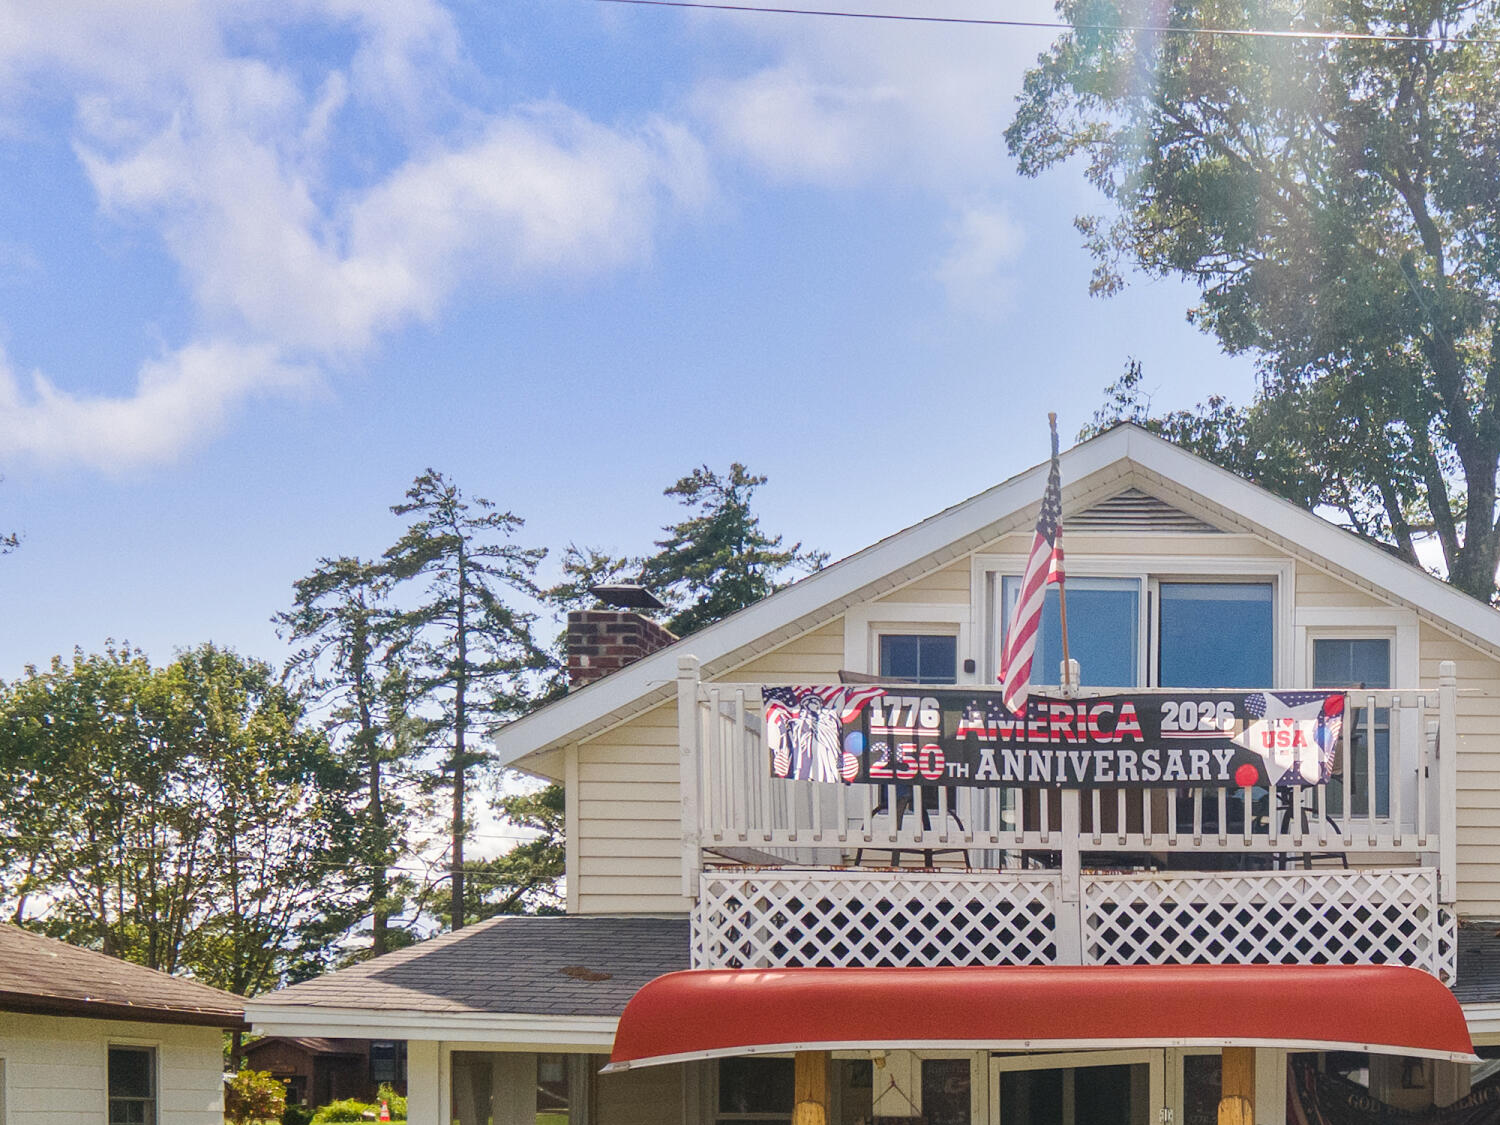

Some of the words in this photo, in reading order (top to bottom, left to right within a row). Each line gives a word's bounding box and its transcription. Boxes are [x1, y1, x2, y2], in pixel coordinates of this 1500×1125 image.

[869, 695, 941, 728] 1776
[955, 699, 1145, 744] AMERICA
[1160, 701, 1236, 731] 2026
[1261, 730, 1308, 748] USA
[974, 748, 1236, 782] ANNIVERSARY
